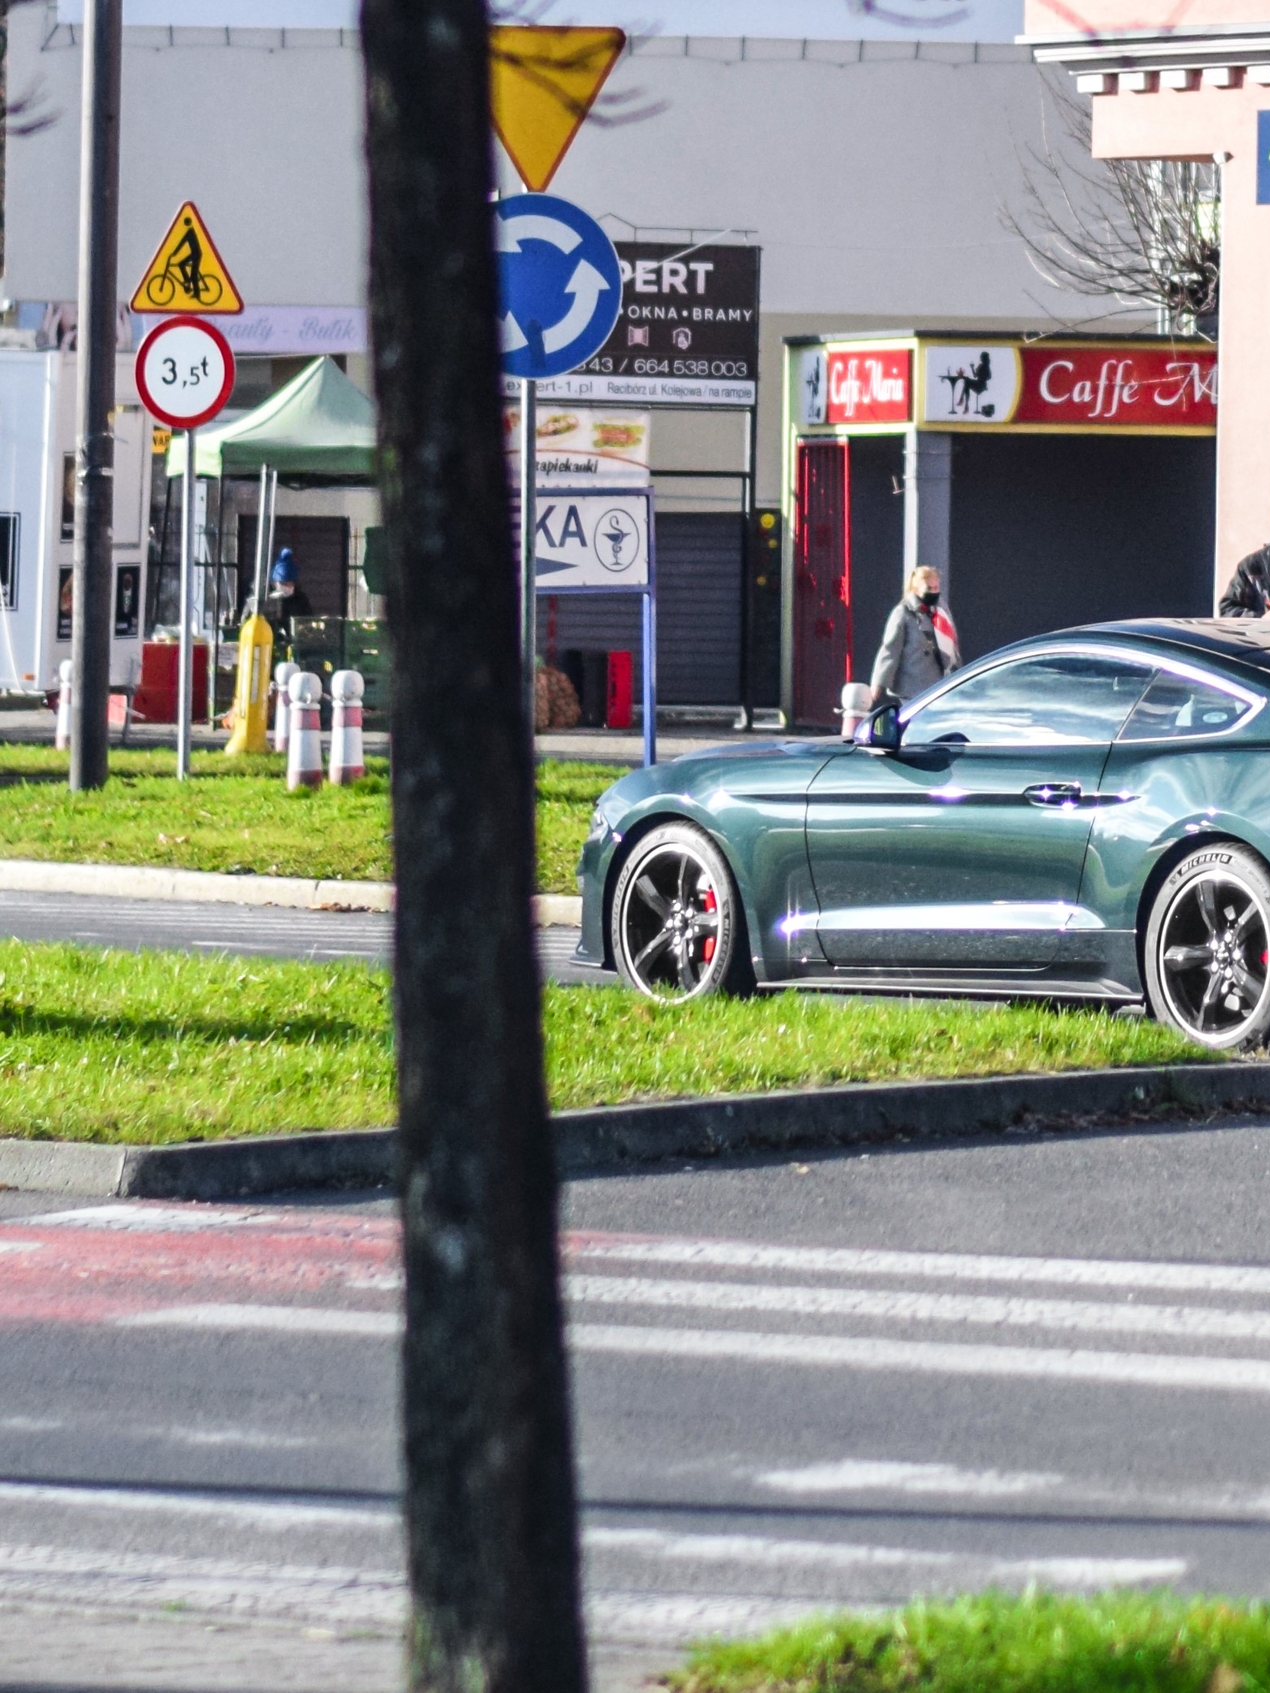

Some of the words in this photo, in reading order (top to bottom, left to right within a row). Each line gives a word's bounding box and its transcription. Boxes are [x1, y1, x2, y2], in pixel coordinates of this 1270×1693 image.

[628, 305, 678, 321] OKNA
[693, 308, 753, 322] BRAMY
[219, 316, 273, 345] auty
[634, 359, 670, 374] 664
[673, 360, 709, 375] 538
[711, 361, 748, 376] 003
[505, 381, 593, 396] exert-1.pl
[862, 358, 904, 404] Maria
[1039, 359, 1140, 418] Caffe
[607, 382, 647, 395] Racibórz
[660, 384, 702, 398] Kolejowa
[708, 387, 719, 397] na
[721, 388, 753, 400] rampie
